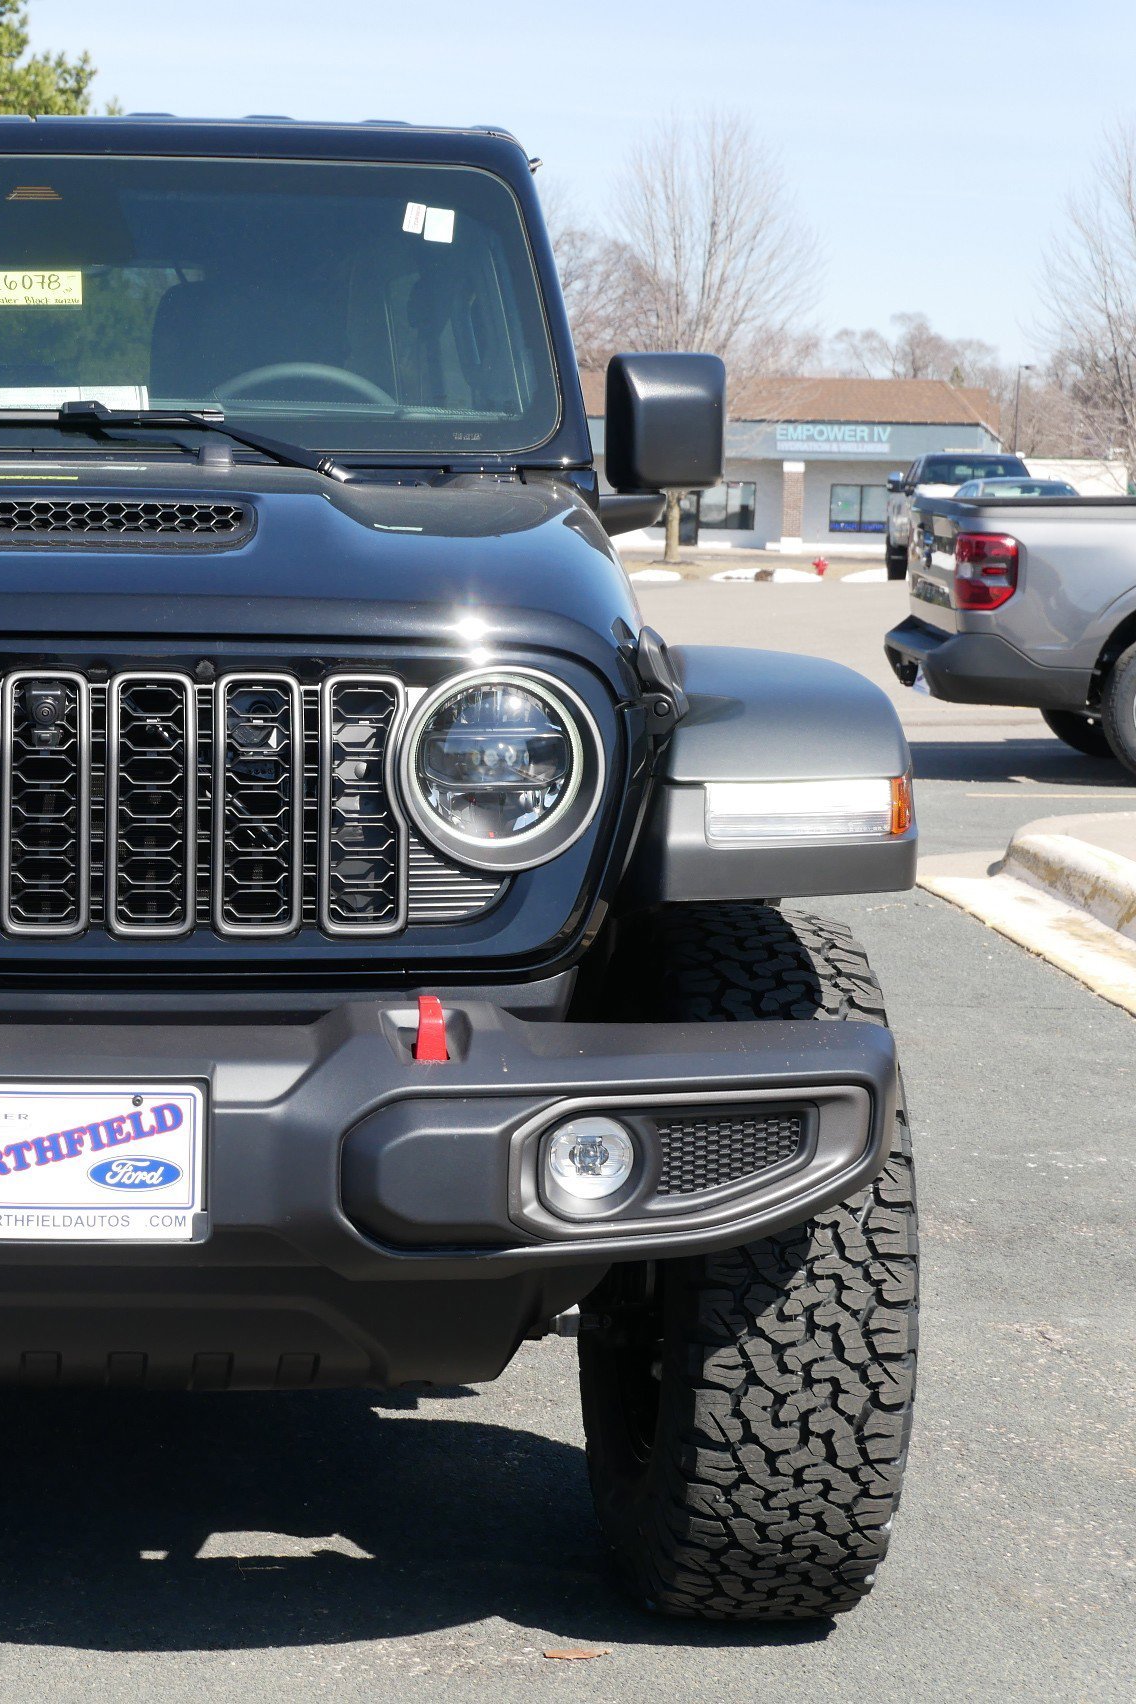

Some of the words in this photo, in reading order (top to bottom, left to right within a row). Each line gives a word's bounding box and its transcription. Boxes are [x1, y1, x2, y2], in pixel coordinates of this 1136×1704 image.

[776, 424, 868, 441] EMPOWER
[873, 426, 891, 442] IV
[105, 1159, 164, 1185] Ford
